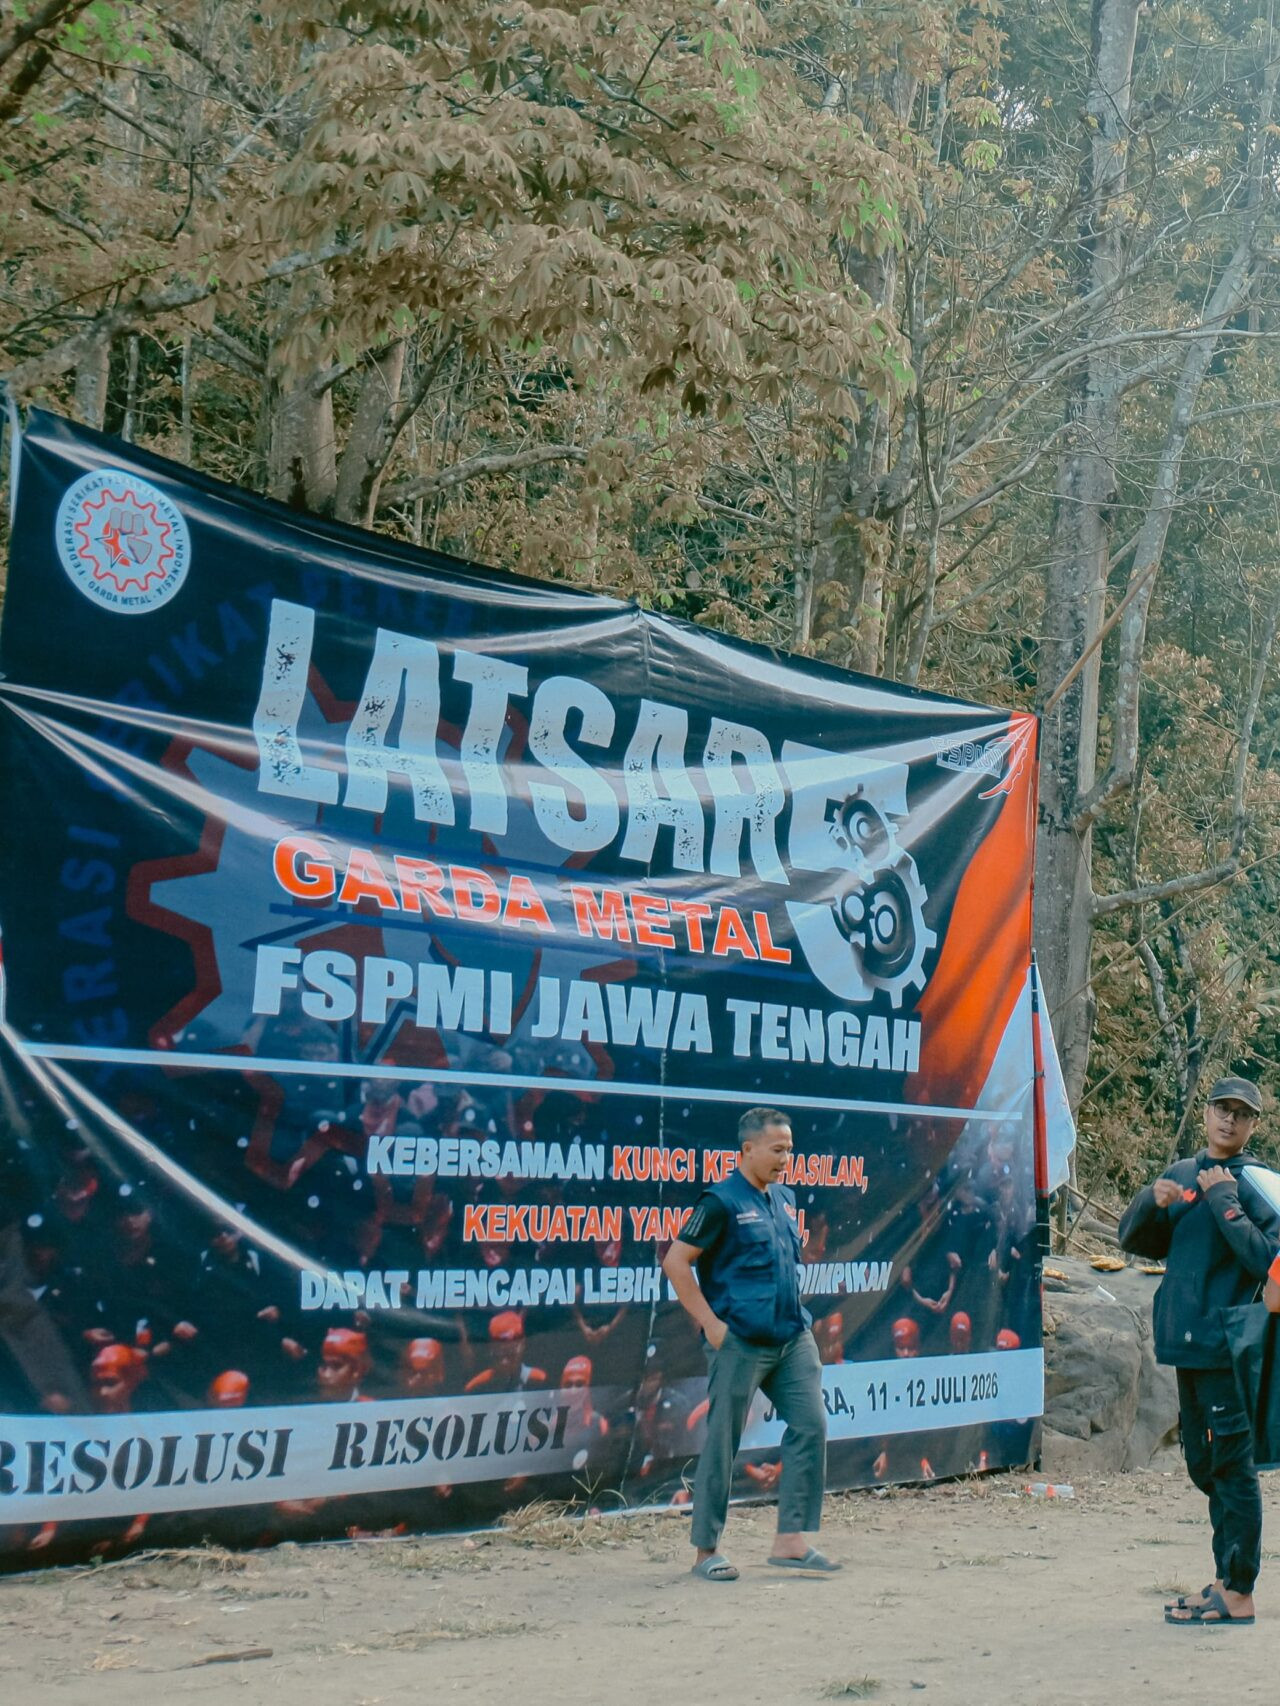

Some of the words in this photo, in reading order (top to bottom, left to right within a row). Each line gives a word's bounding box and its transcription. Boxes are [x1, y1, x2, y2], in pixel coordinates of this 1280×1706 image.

[68, 476, 104, 515] SERIKAT
[159, 498, 182, 534] METAL
[155, 538, 185, 597] INDONESIA
[87, 580, 119, 604] GARDA
[121, 594, 153, 607] METAL
[253, 598, 790, 885] LATSAR
[273, 836, 556, 934] GARDA
[571, 886, 792, 964] METAL
[253, 945, 512, 1036] FSPMI
[531, 973, 713, 1054] JAWA
[726, 999, 921, 1073] TENGAH
[366, 1134, 604, 1181] KEBERSAMAAN
[612, 1144, 695, 1183] KUNCI
[463, 1204, 622, 1242] KEKUATAN
[301, 1269, 409, 1310] DAPAT
[415, 1267, 576, 1308] MENCAPAI
[584, 1266, 662, 1304] LEBIH
[867, 1381, 888, 1412] 11
[906, 1378, 926, 1408] 12
[931, 1374, 967, 1406] JULI
[971, 1372, 998, 1401] 2026
[328, 1405, 571, 1472] RESOLUSI
